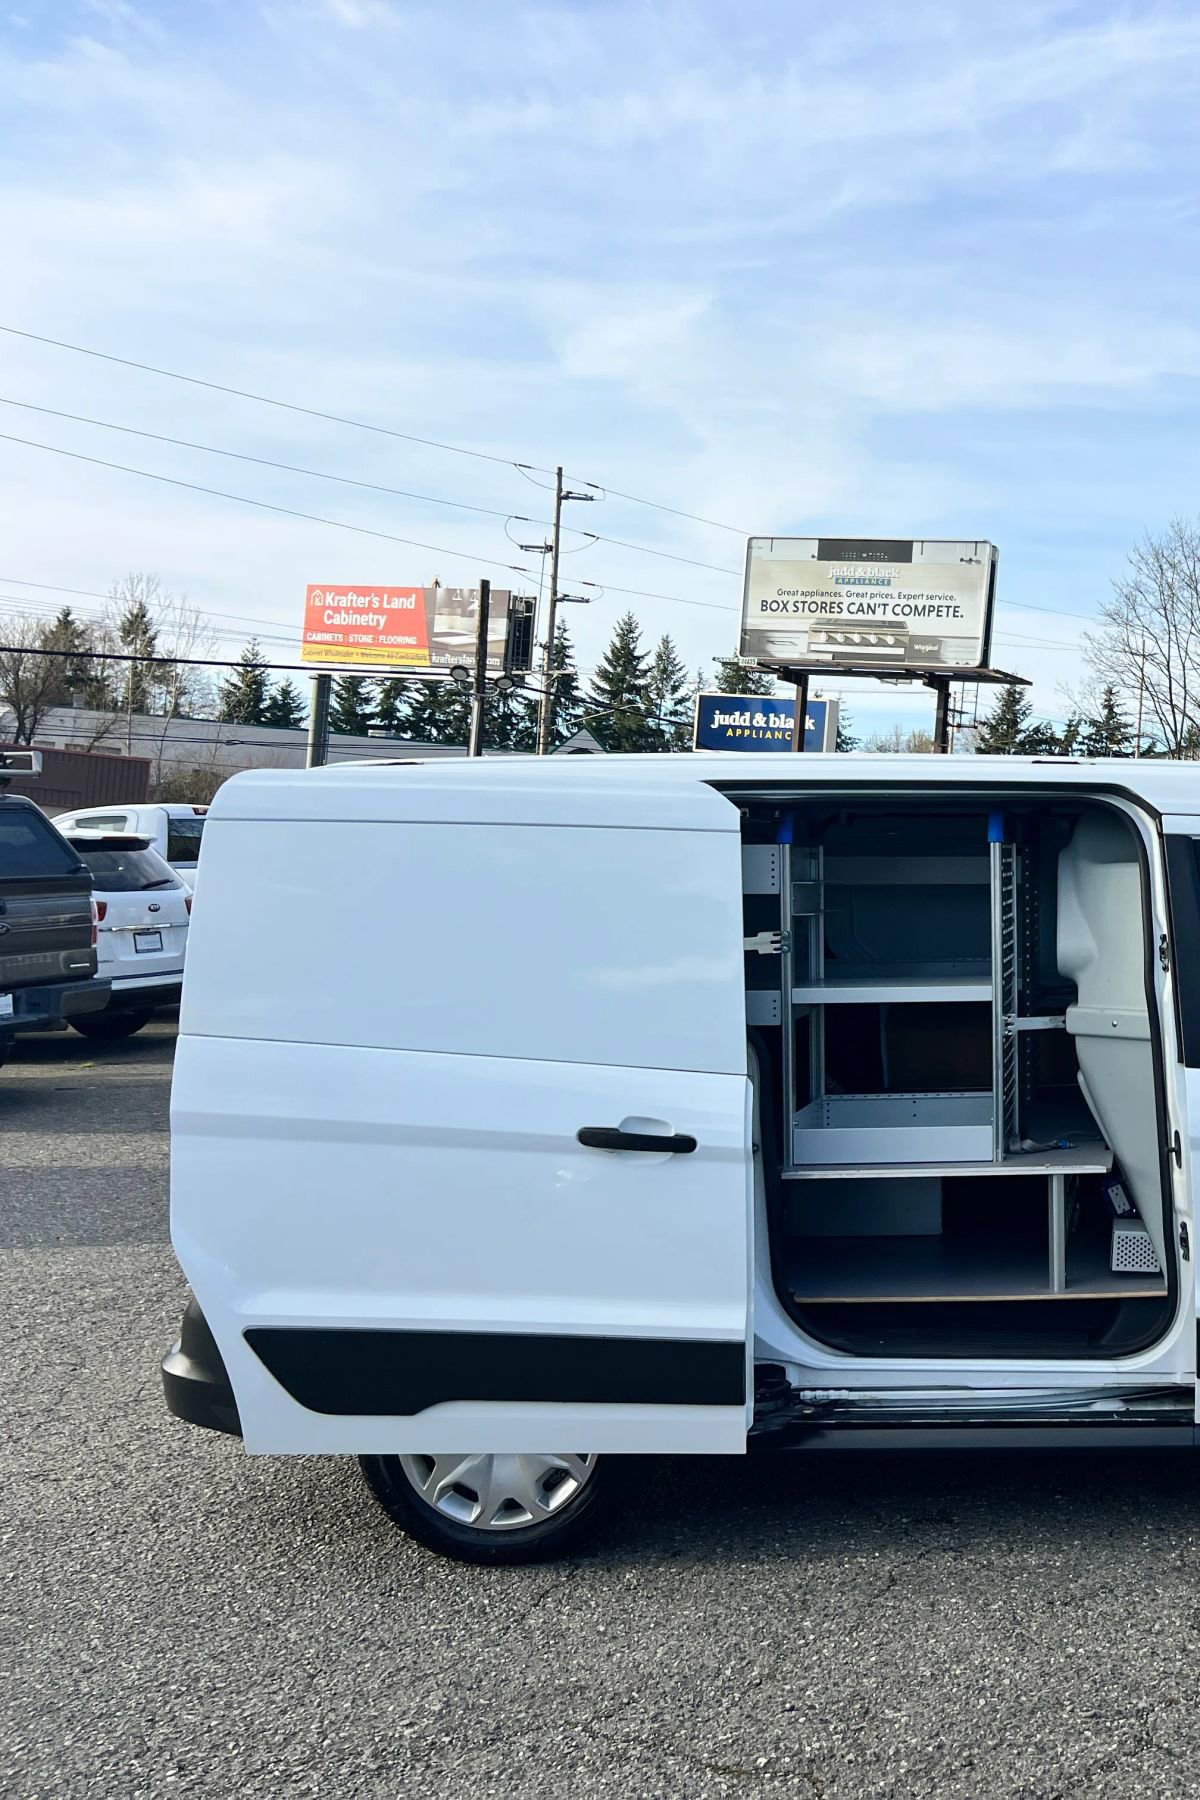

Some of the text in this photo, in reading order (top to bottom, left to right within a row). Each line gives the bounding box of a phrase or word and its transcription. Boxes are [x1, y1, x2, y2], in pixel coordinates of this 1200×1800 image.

[325, 591, 380, 609] Krafter's
[383, 593, 415, 609] Land
[777, 588, 957, 602] Great appliances. Great prices. Expert service.
[760, 599, 964, 619] BOX STORES CAN'T COMPETE.
[323, 609, 388, 630] Cabinetry
[306, 632, 417, 645] CABINETS STONE FLOORING
[710, 709, 816, 730] judd & blak
[726, 728, 793, 741] APPLIANC
